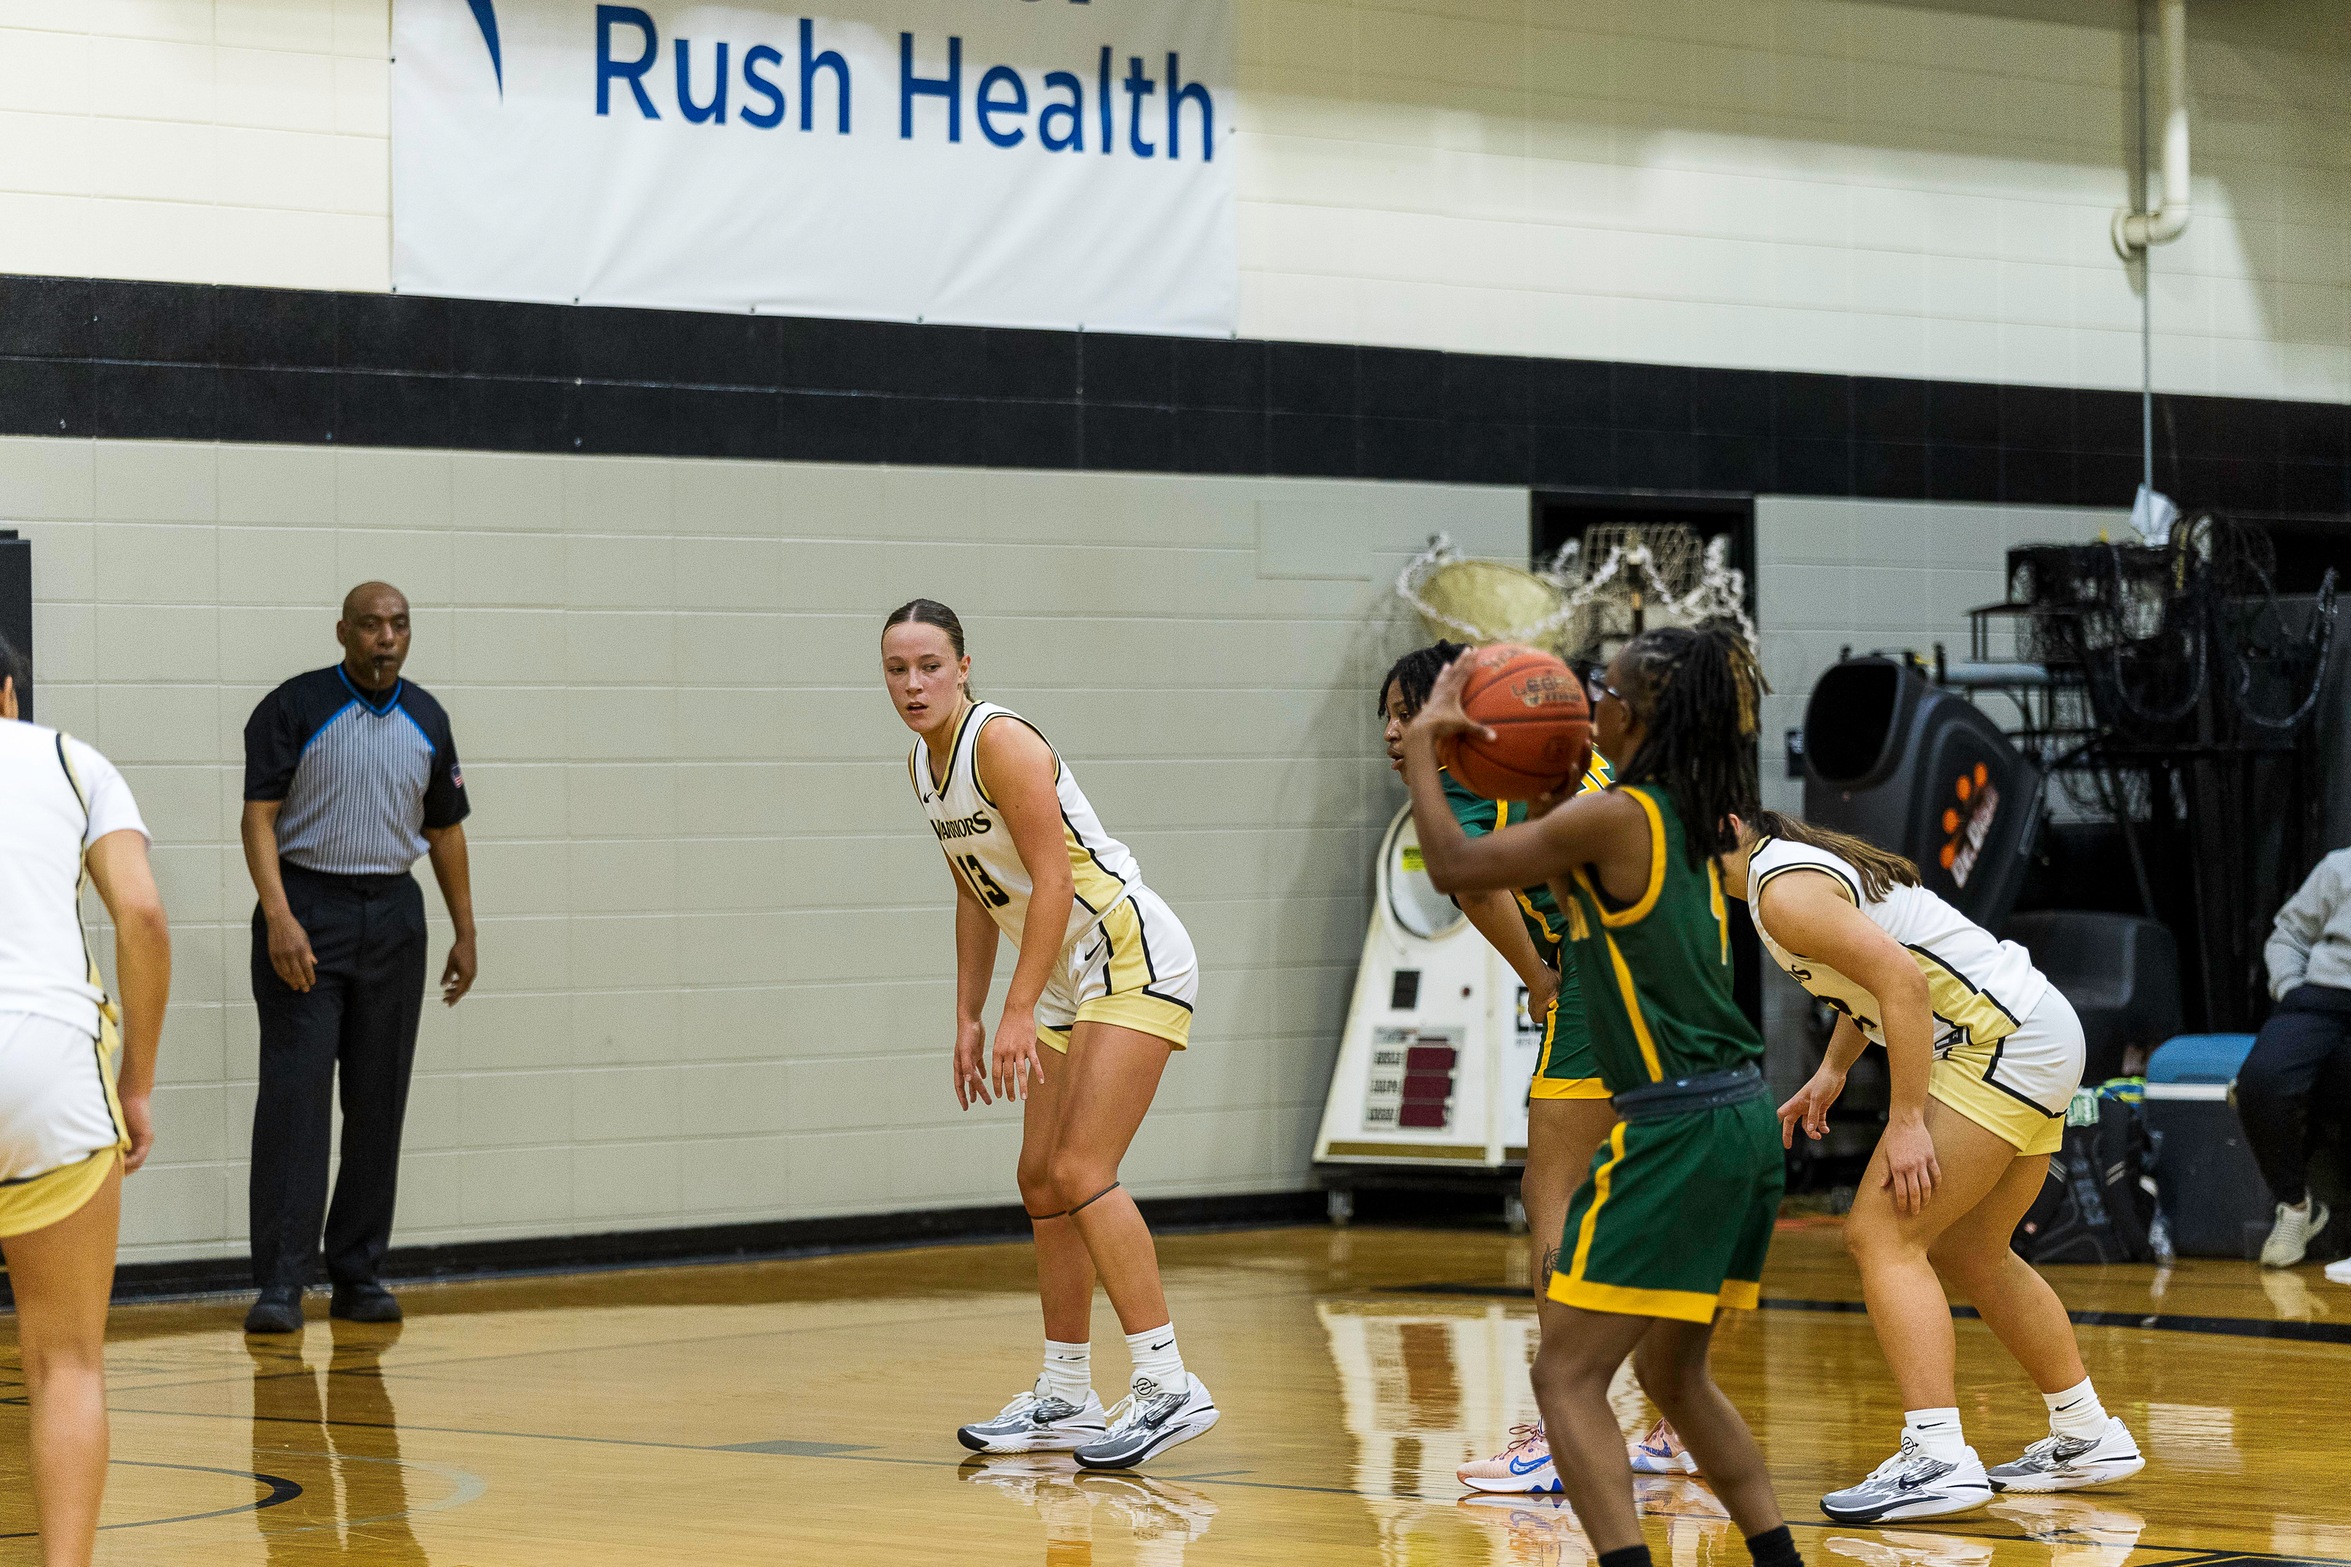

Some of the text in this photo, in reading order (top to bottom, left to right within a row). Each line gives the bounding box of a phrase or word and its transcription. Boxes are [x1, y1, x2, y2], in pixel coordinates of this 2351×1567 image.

[595, 4, 1214, 162] Rush Health
[955, 853, 1010, 909] 13
